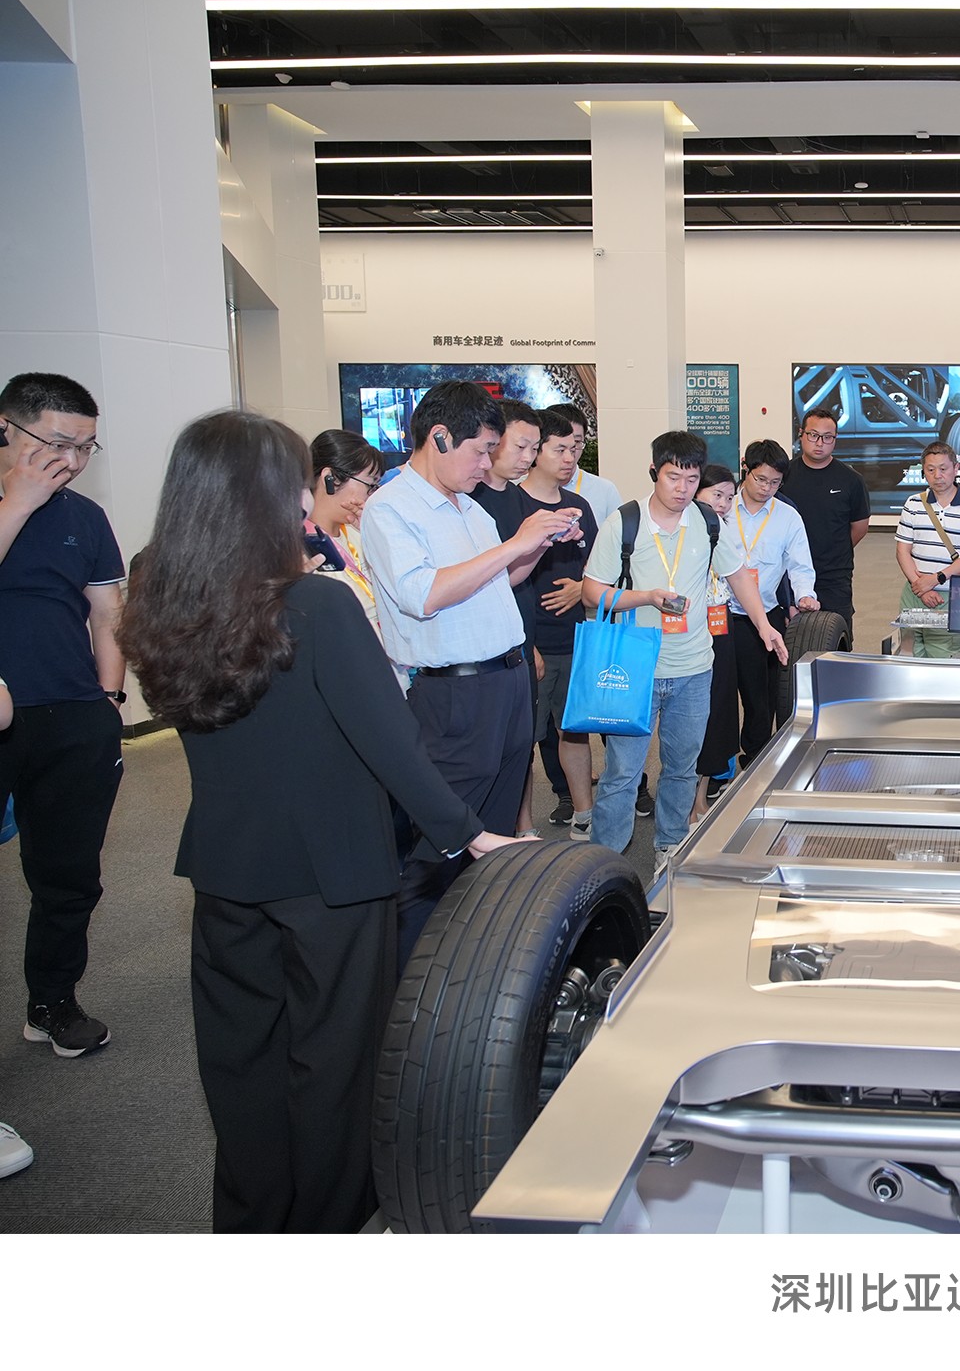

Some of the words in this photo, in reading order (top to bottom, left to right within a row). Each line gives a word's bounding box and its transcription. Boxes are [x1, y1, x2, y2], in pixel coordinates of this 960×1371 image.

[432, 335, 504, 347] 商用车全球足迹
[532, 339, 563, 348] Footprint
